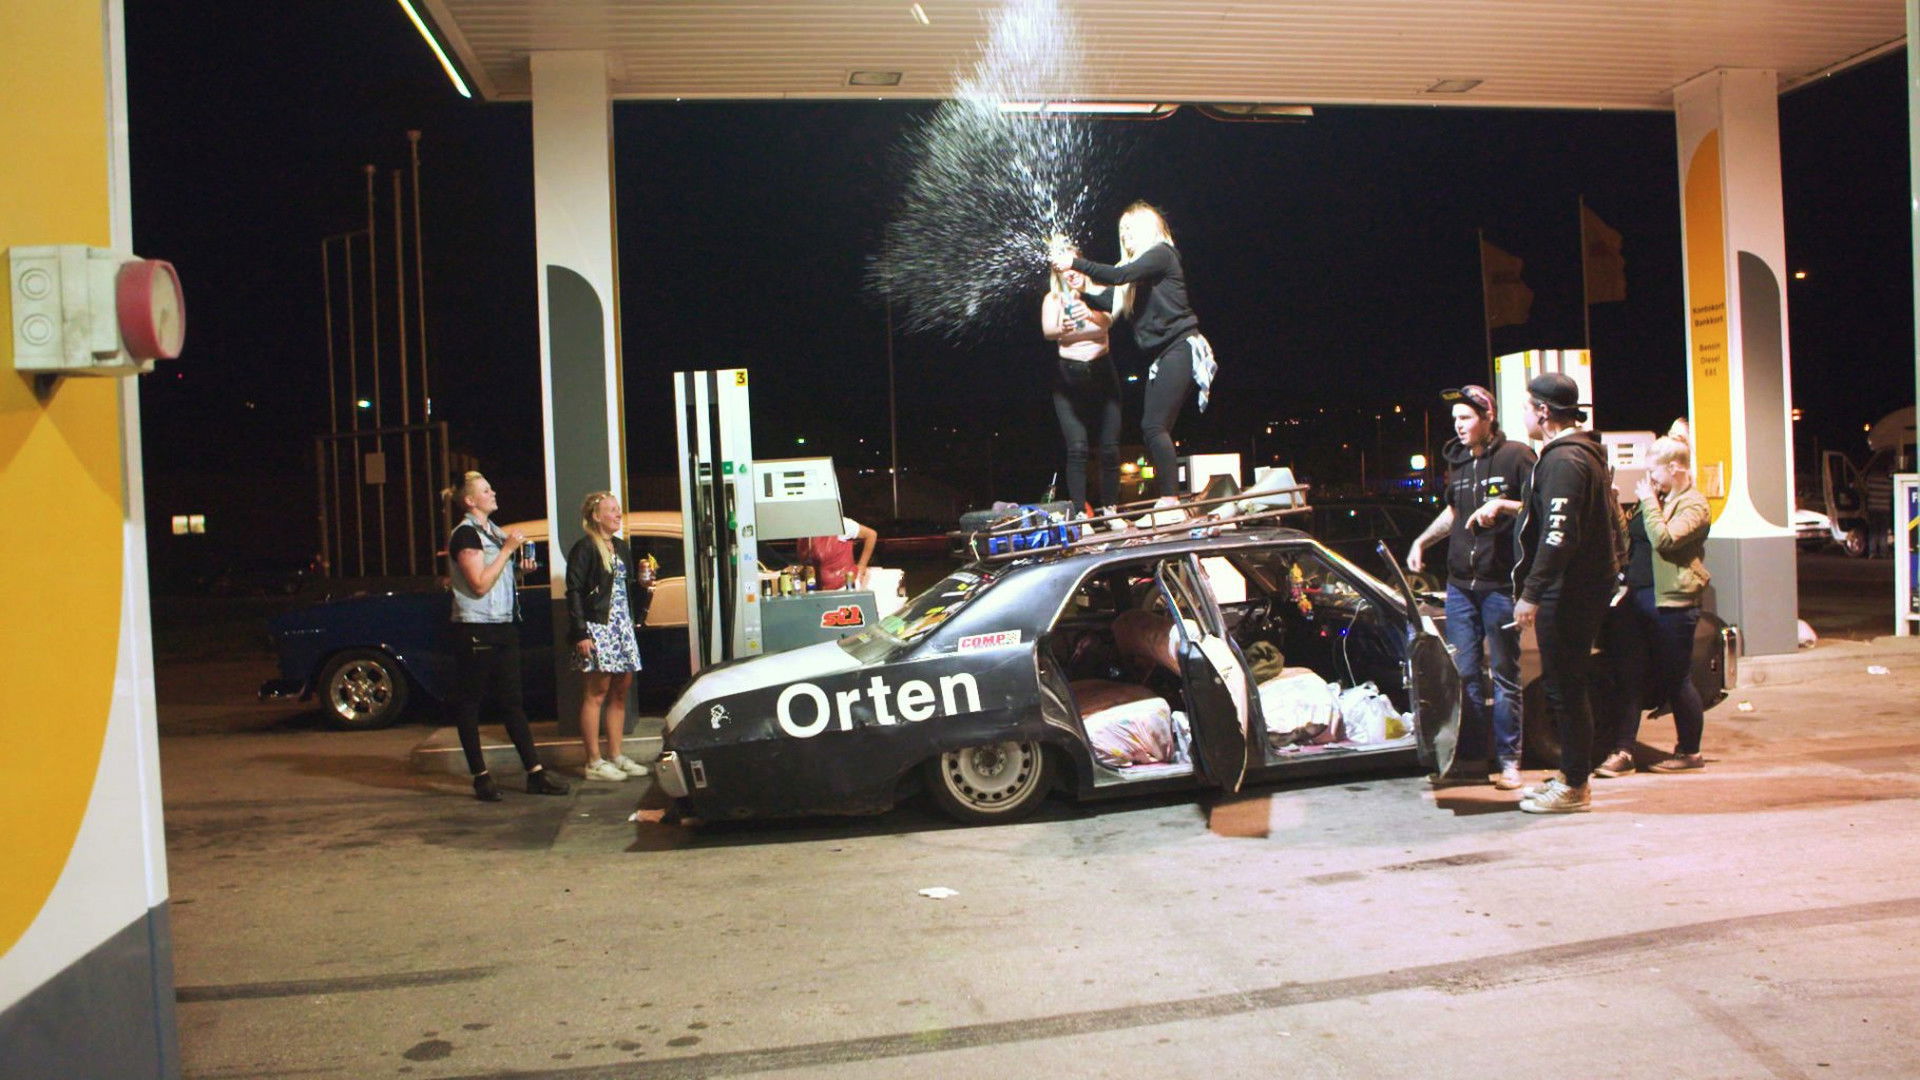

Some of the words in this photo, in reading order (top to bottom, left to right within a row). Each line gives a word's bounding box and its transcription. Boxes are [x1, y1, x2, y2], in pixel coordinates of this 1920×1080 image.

[1695, 316, 1723, 327] Bankkort
[1700, 356, 1721, 364] Diesel
[737, 372, 745, 384] 3
[1546, 498, 1569, 546] TTS
[961, 634, 1006, 649] COMP
[776, 672, 982, 738] Orten
